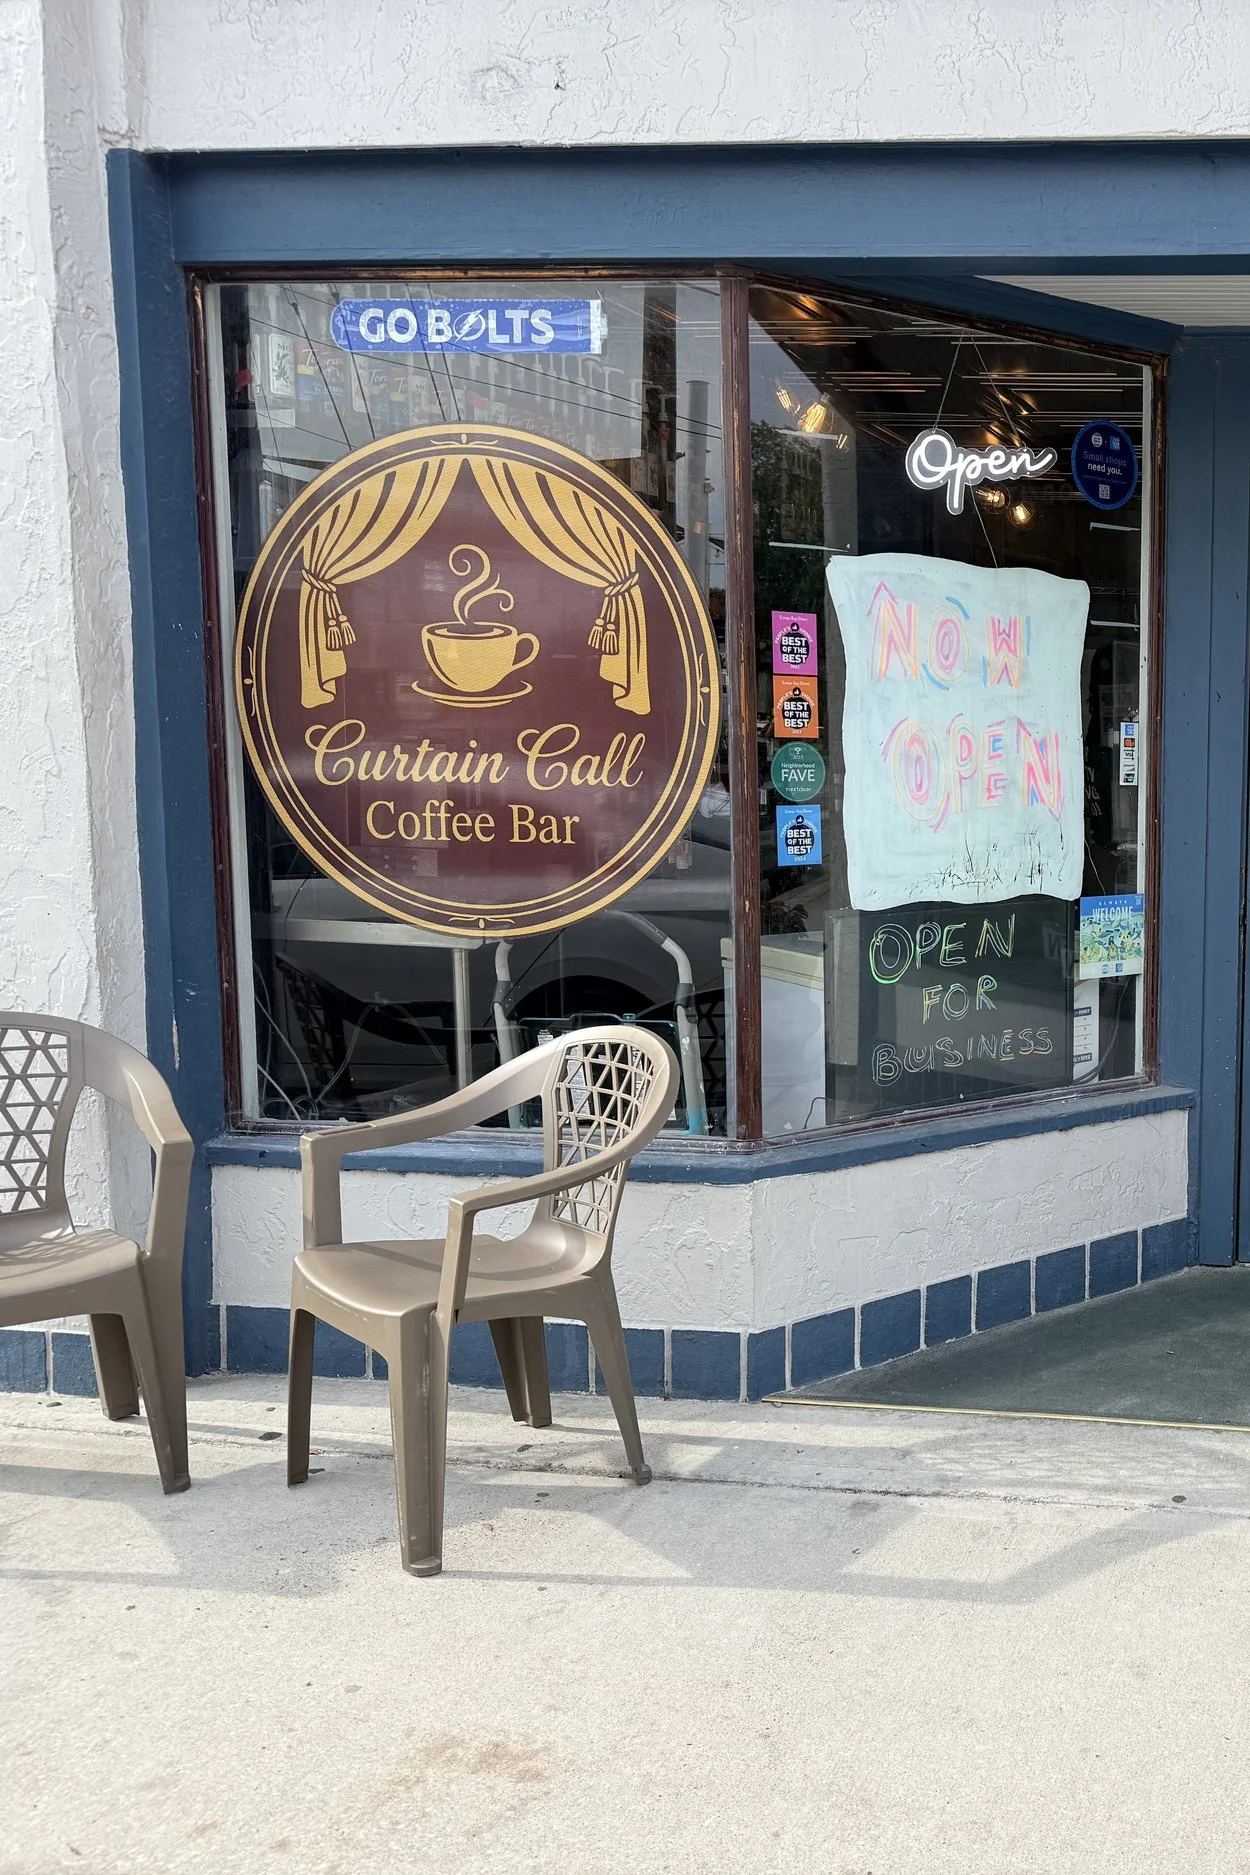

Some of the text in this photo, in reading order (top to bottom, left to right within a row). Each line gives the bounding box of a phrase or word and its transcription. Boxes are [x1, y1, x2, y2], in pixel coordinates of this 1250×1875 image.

[359, 308, 417, 344] GO
[1083, 450, 1103, 463] Small
[912, 434, 1053, 509] Open
[1088, 463, 1122, 475] need you.
[782, 637, 807, 646] BEST
[868, 582, 1031, 690] NOW
[782, 654, 807, 663] BEST
[784, 702, 809, 710] BEST
[784, 719, 809, 728] BEST
[305, 719, 646, 791] Curtain Call
[781, 769, 816, 782] FAVE
[881, 713, 1064, 832] OPEN
[366, 800, 580, 844] Coffee Bar
[787, 829, 812, 838] BEST
[787, 845, 812, 855] BEST
[1092, 906, 1133, 922] WELCOME
[869, 913, 1016, 985] OPEN
[922, 975, 998, 1024] FOR
[872, 1027, 1053, 1087] BUSINESS
